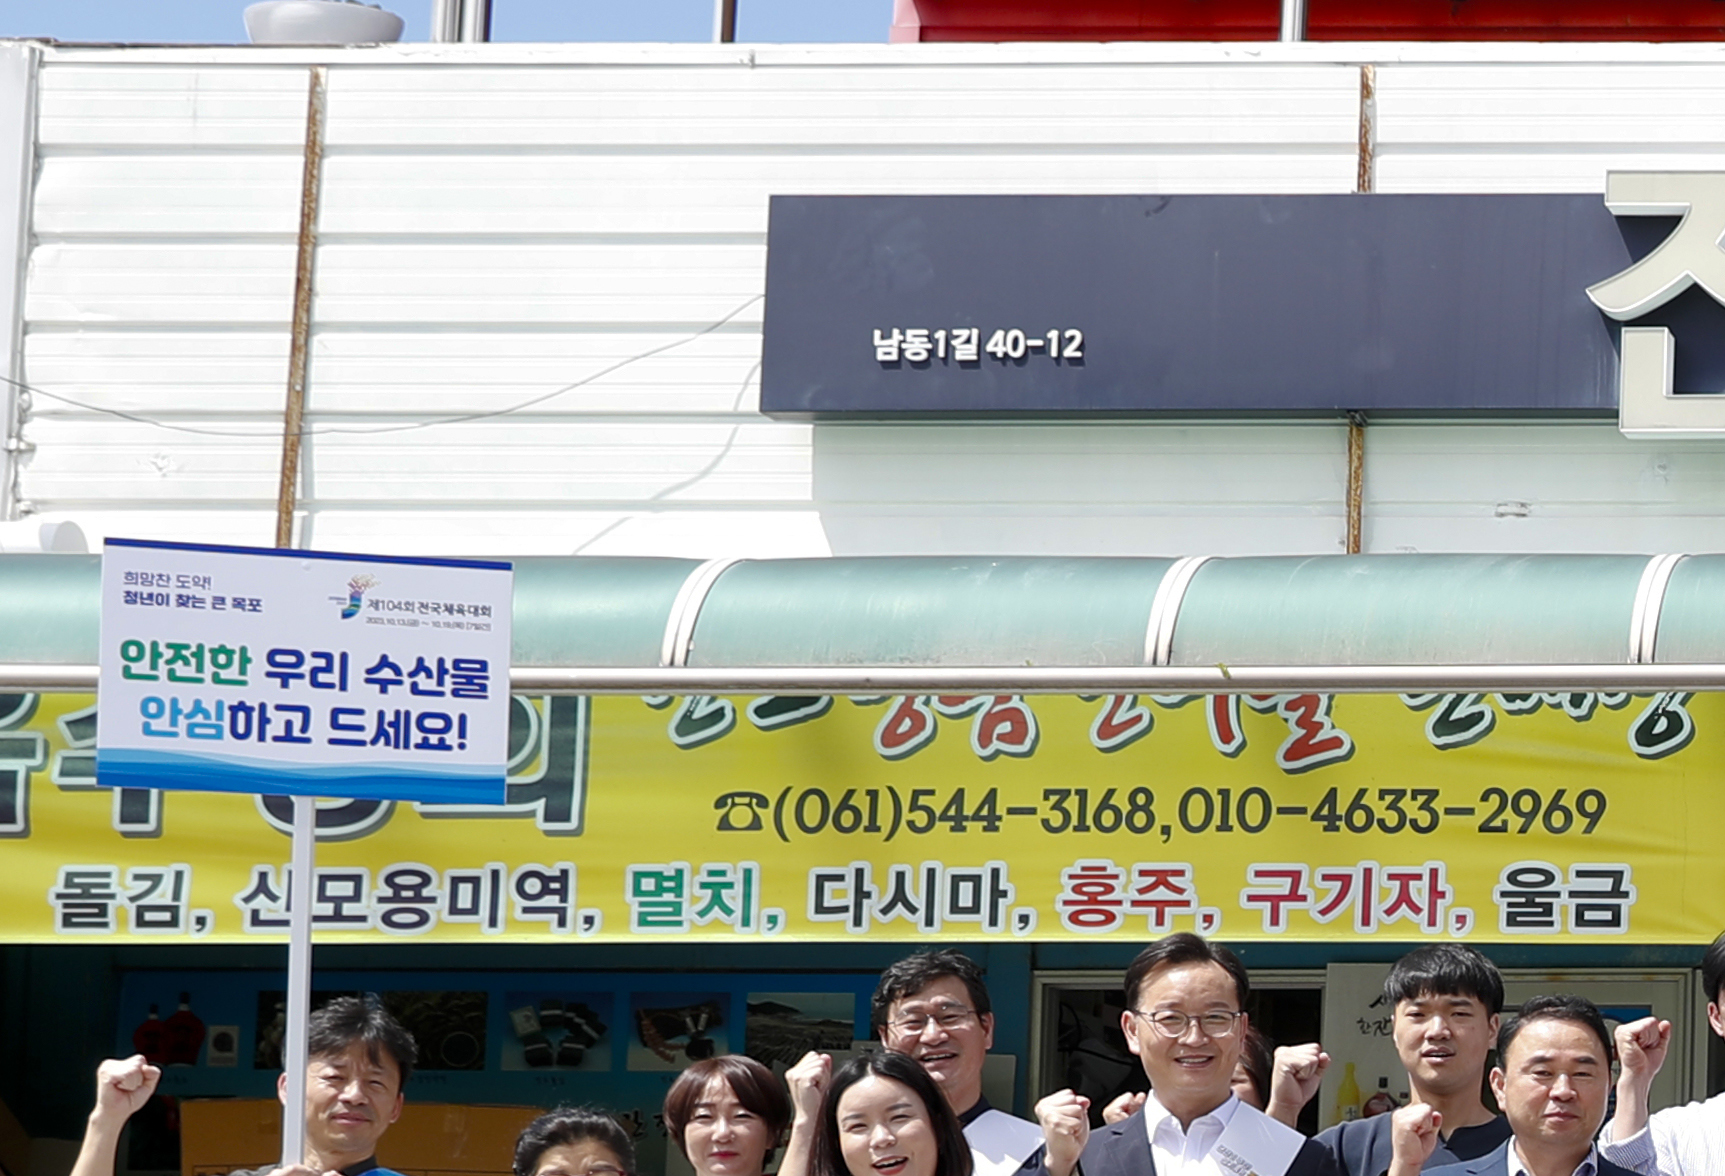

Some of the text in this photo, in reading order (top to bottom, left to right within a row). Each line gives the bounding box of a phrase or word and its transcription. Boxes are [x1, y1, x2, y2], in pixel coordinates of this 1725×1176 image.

[871, 327, 1085, 363] 남동1길 40-12
[122, 590, 171, 608] 청년이
[120, 638, 491, 701] 안전한 우리 수산물
[139, 695, 469, 752] 안심하고 드세요!
[54, 866, 211, 934] 돌김,
[630, 866, 784, 934] 멸치,
[809, 865, 1036, 934] 다시마,
[1061, 863, 1219, 933] 홍주,
[1243, 863, 1469, 933] 구기자,
[1496, 864, 1634, 931] 울금
